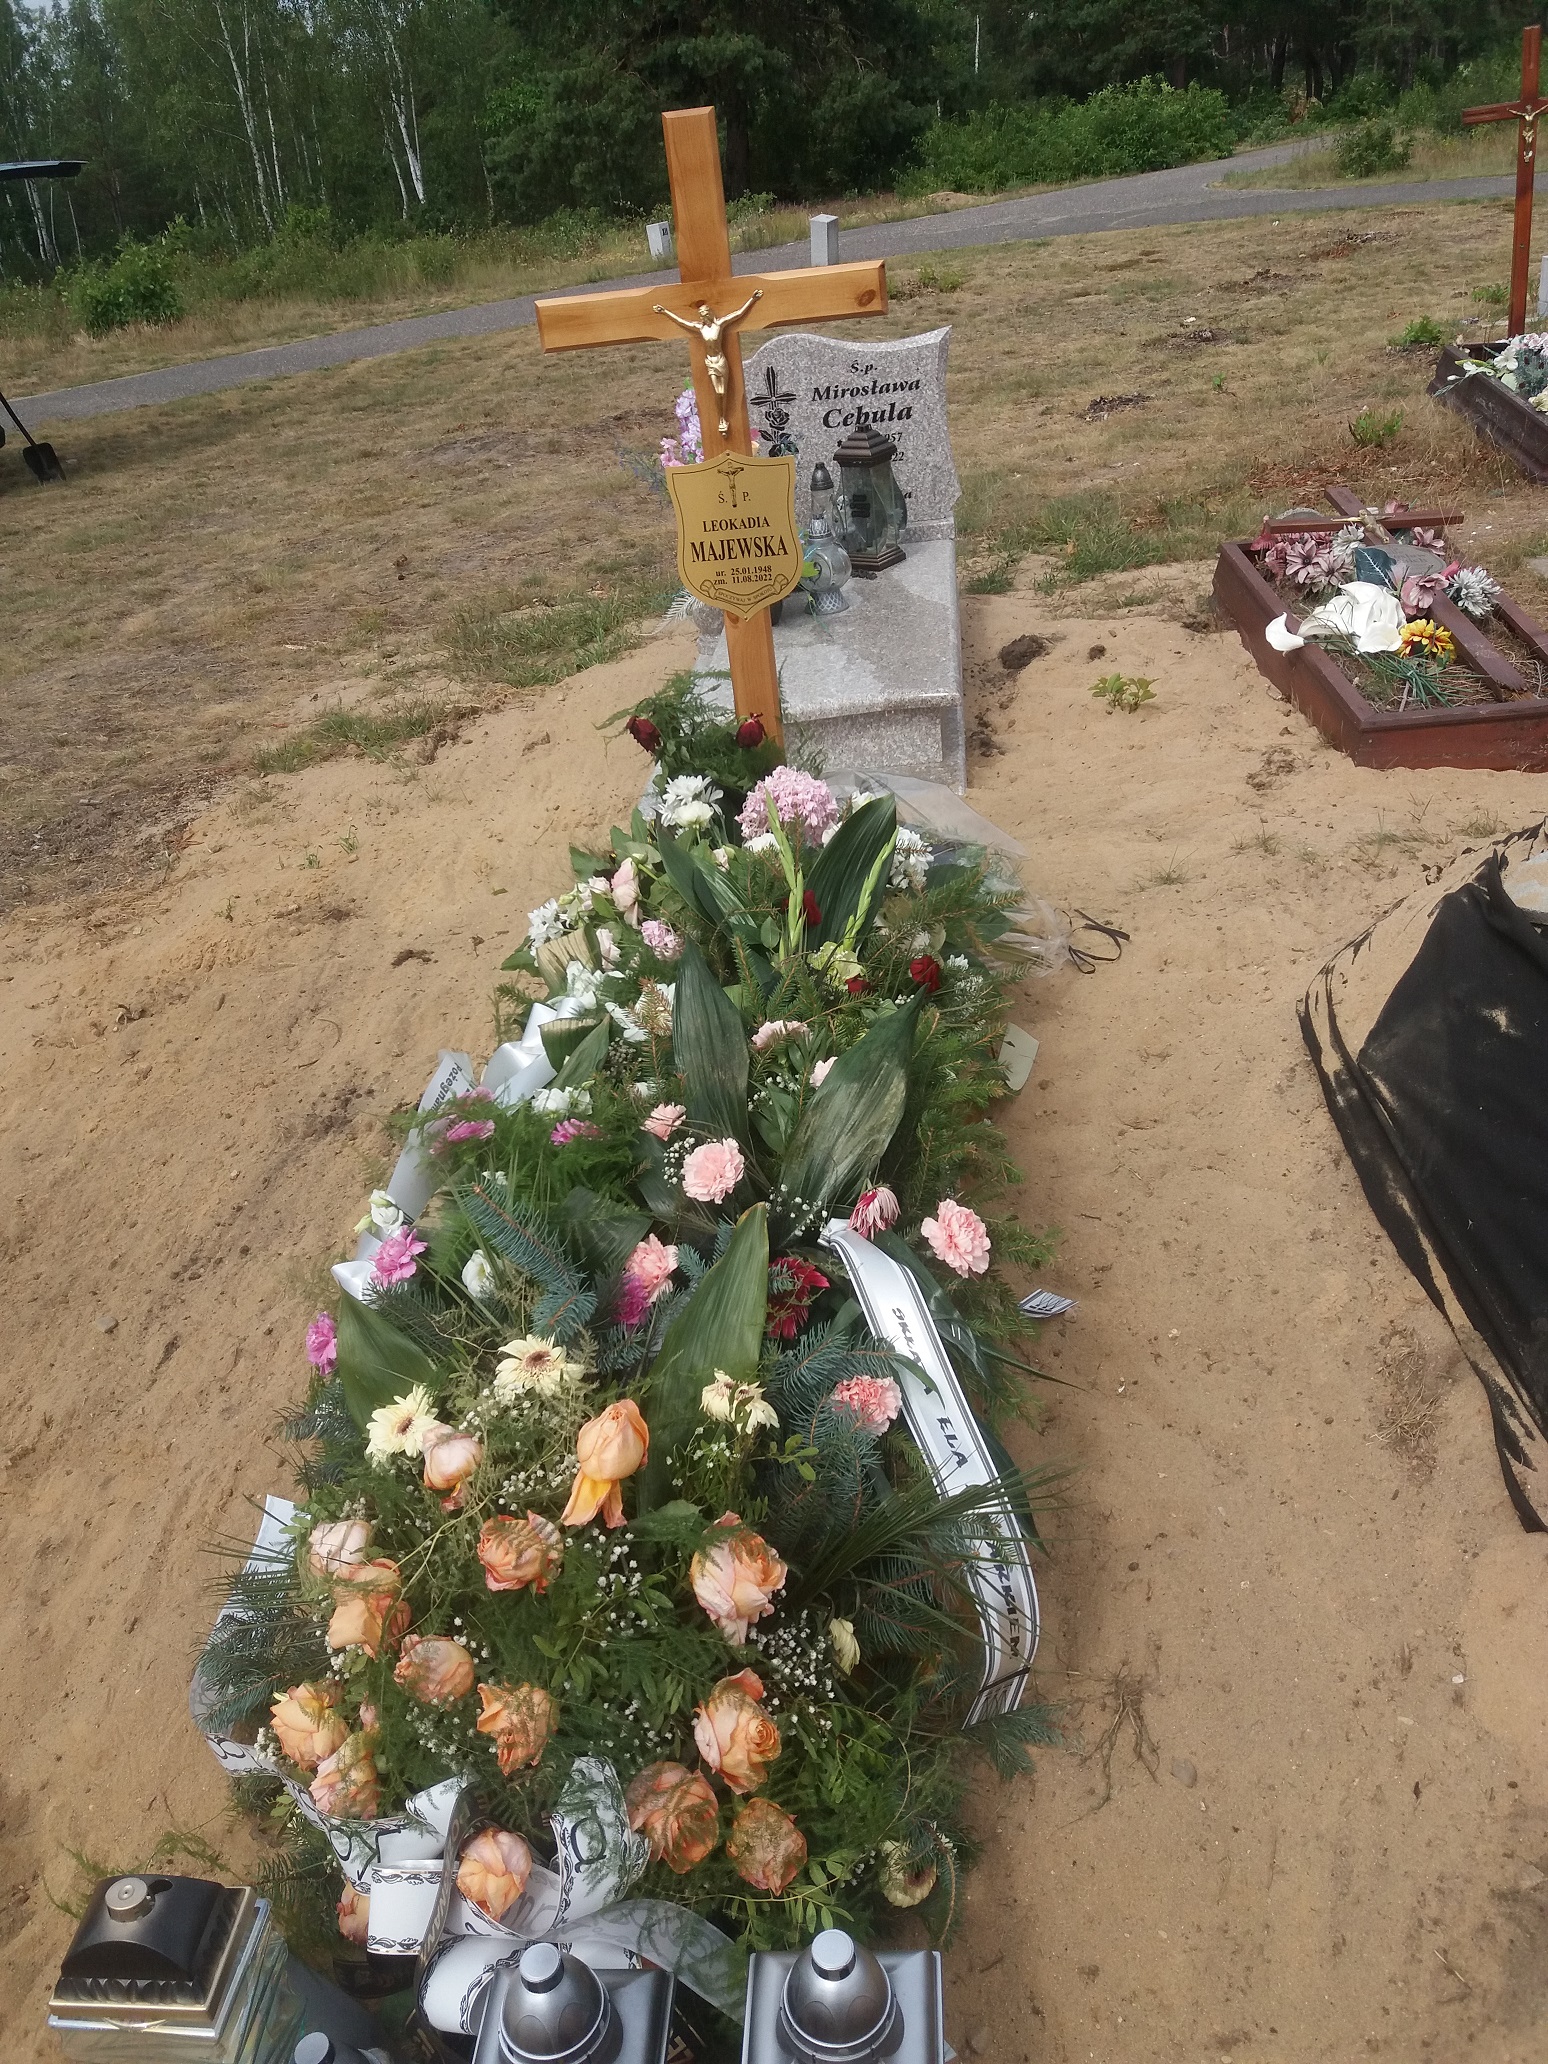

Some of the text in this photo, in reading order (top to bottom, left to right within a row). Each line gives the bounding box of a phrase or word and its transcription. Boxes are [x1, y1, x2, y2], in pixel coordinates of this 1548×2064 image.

[811, 379, 921, 402] Mirosława
[822, 401, 913, 429] Cebula
[742, 491, 752, 502] P.
[702, 516, 771, 533] LEOKADIA
[690, 534, 789, 563] MAJEWSKA
[730, 565, 772, 576] 25.01.1948
[713, 573, 773, 586] zm. 11.08.2022
